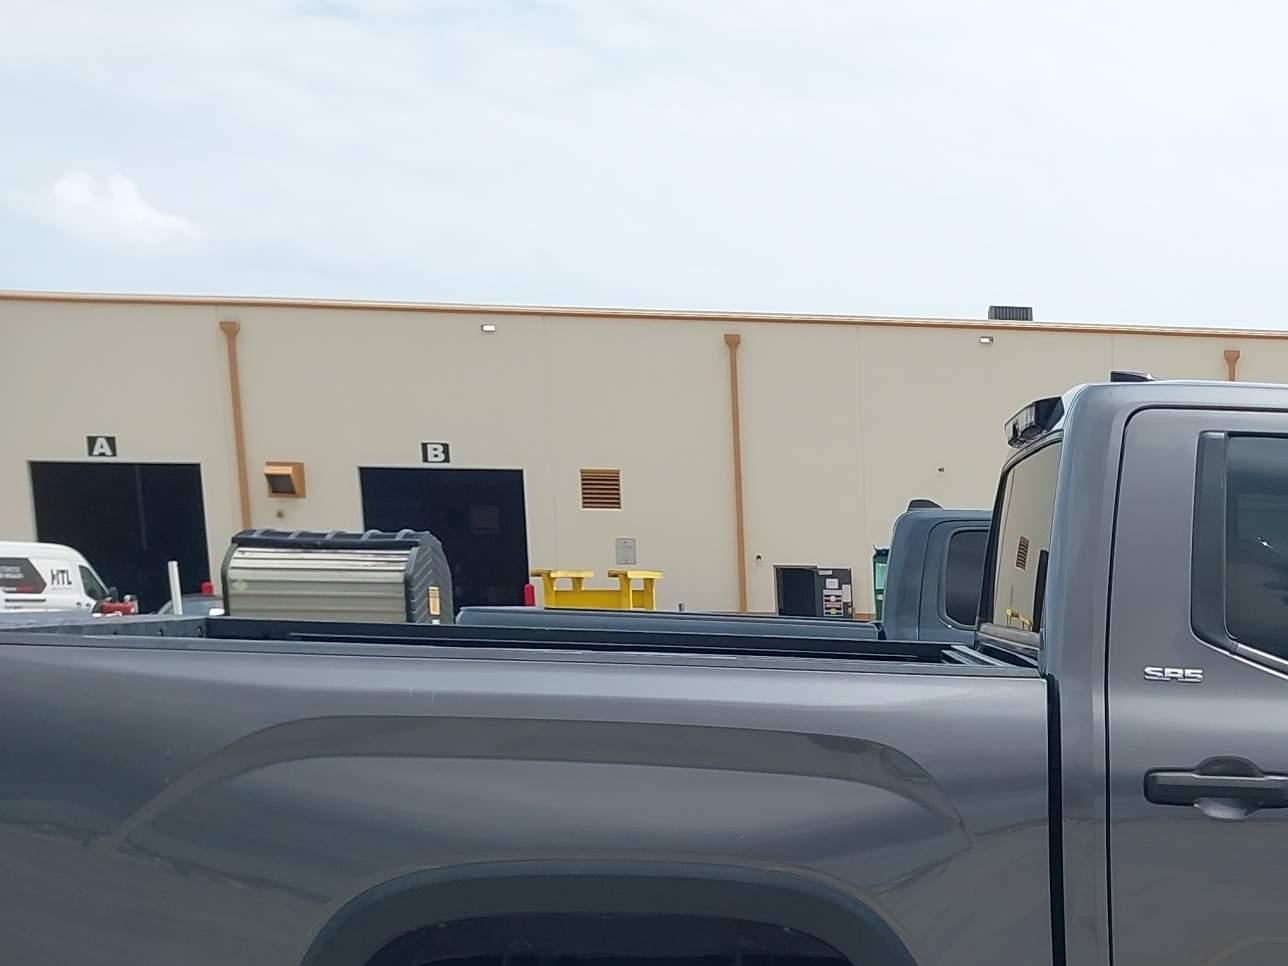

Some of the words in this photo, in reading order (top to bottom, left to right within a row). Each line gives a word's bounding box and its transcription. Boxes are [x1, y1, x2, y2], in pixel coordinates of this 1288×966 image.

[93, 437, 112, 455] A
[427, 443, 445, 462] B
[1144, 666, 1204, 682] SR5
